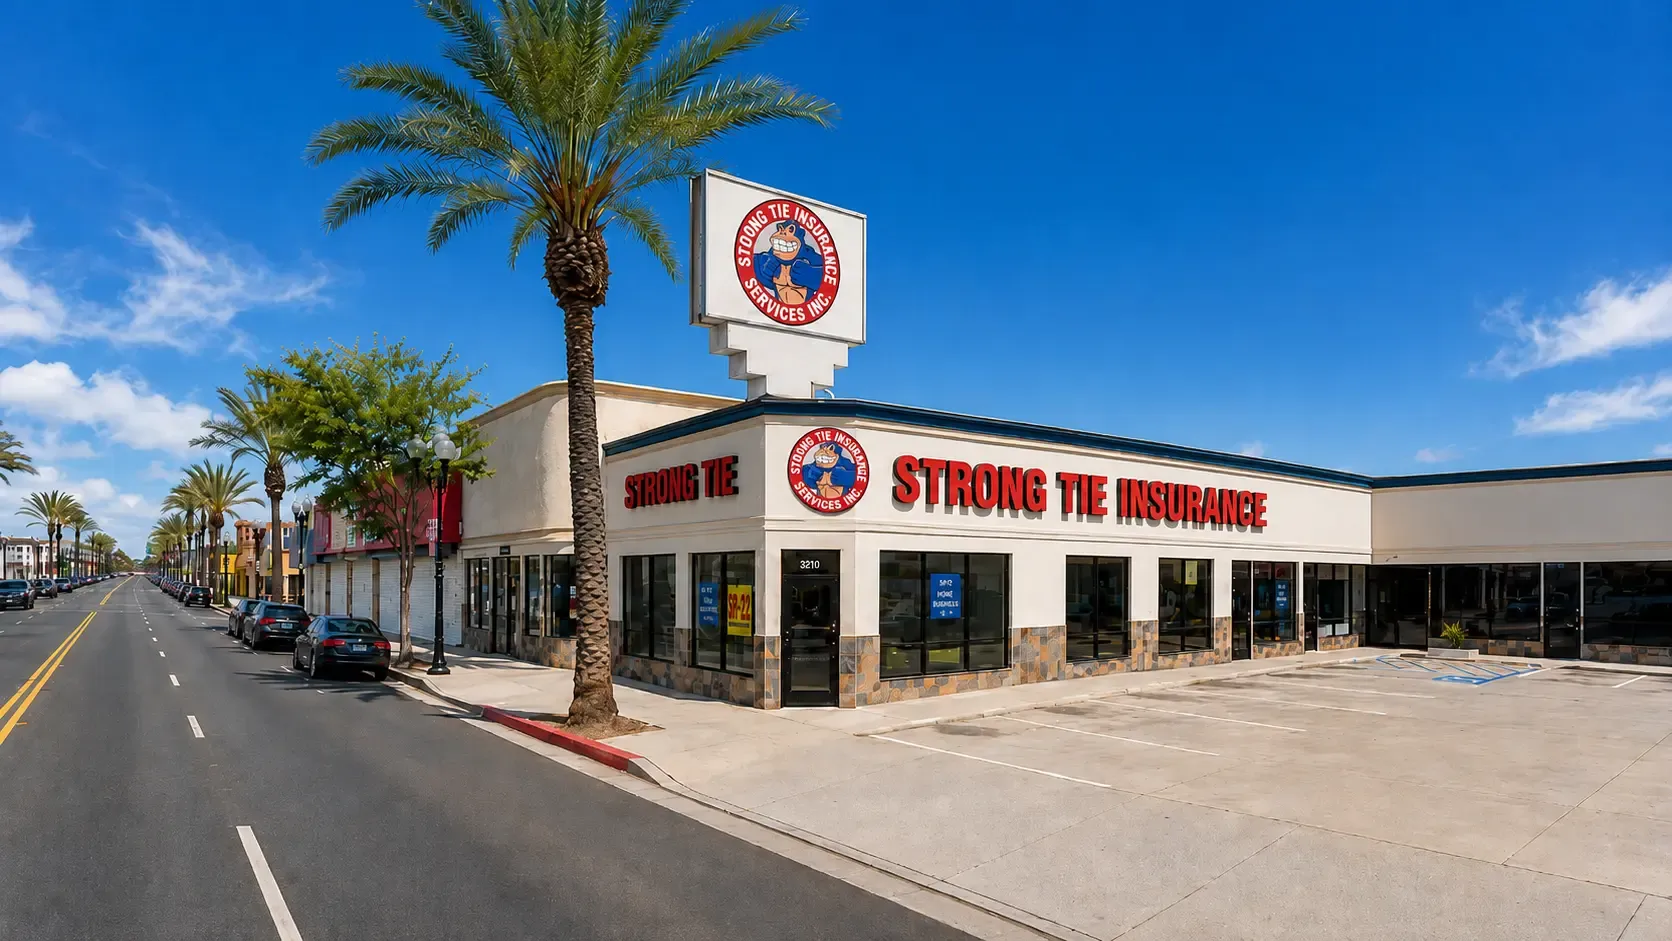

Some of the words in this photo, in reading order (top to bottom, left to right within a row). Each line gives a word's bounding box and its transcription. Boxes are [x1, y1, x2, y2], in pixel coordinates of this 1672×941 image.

[768, 204, 790, 219] TIE
[794, 207, 837, 286] INSURANCE
[744, 277, 805, 321] SERVICES
[807, 293, 832, 317] INC.
[815, 431, 832, 442] TIE
[624, 463, 699, 509] STRONG
[701, 455, 739, 497] TIE
[794, 481, 842, 509] SERVICES
[892, 454, 1047, 512] STRONG
[1056, 472, 1108, 516] TIE
[1116, 477, 1268, 527] INSURANCE
[800, 560, 820, 569] 3210
